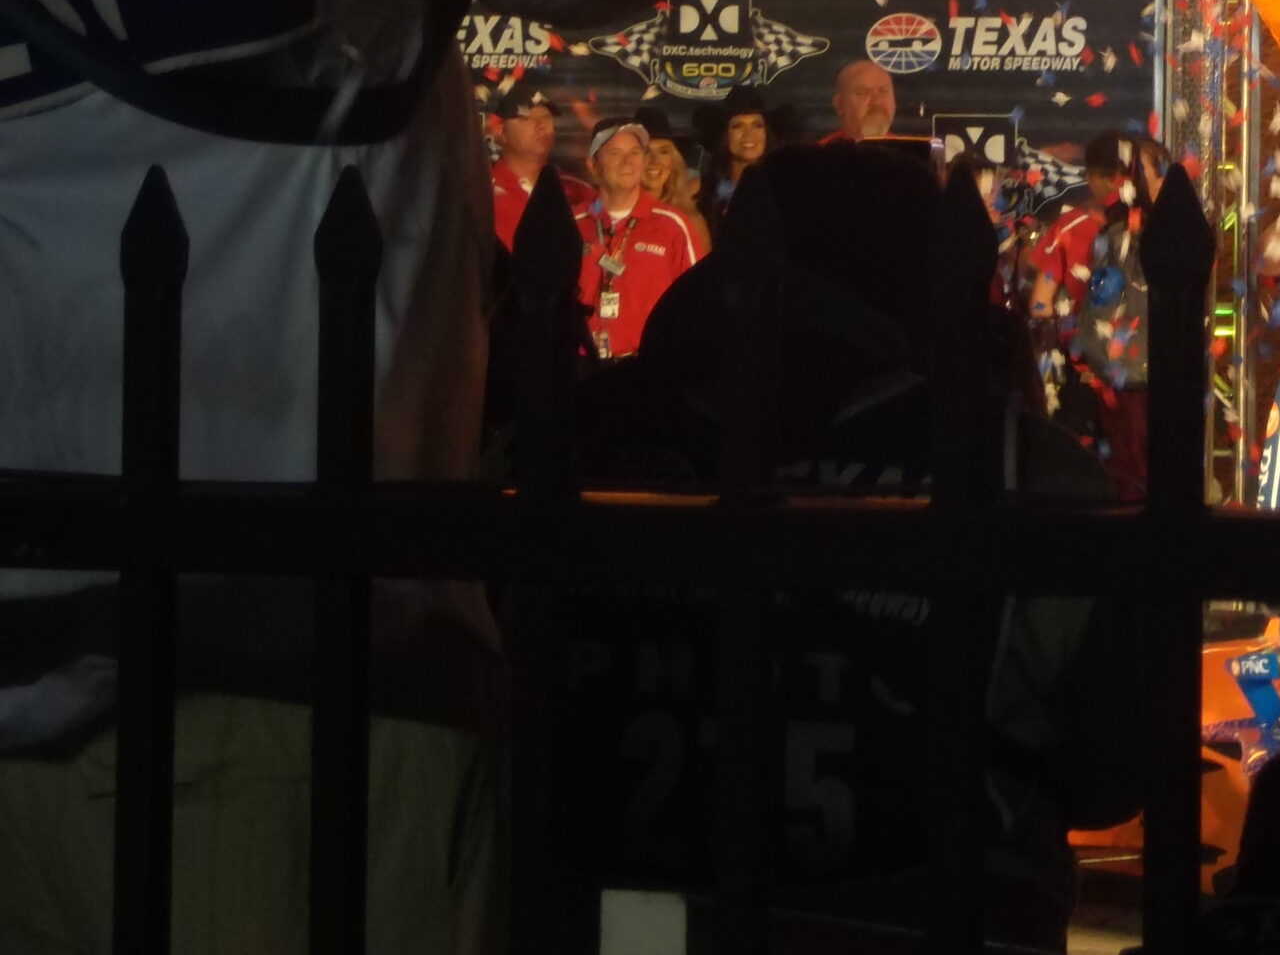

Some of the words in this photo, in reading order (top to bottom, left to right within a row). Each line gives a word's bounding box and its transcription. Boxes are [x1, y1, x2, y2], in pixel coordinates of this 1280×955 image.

[949, 16, 1088, 56] TEXAS
[662, 45, 754, 59] DXC.technology
[682, 62, 736, 78] 600
[948, 55, 1000, 71] MOTOR
[1004, 56, 1081, 71] SPEEDWAY
[1241, 657, 1270, 674] PNC
